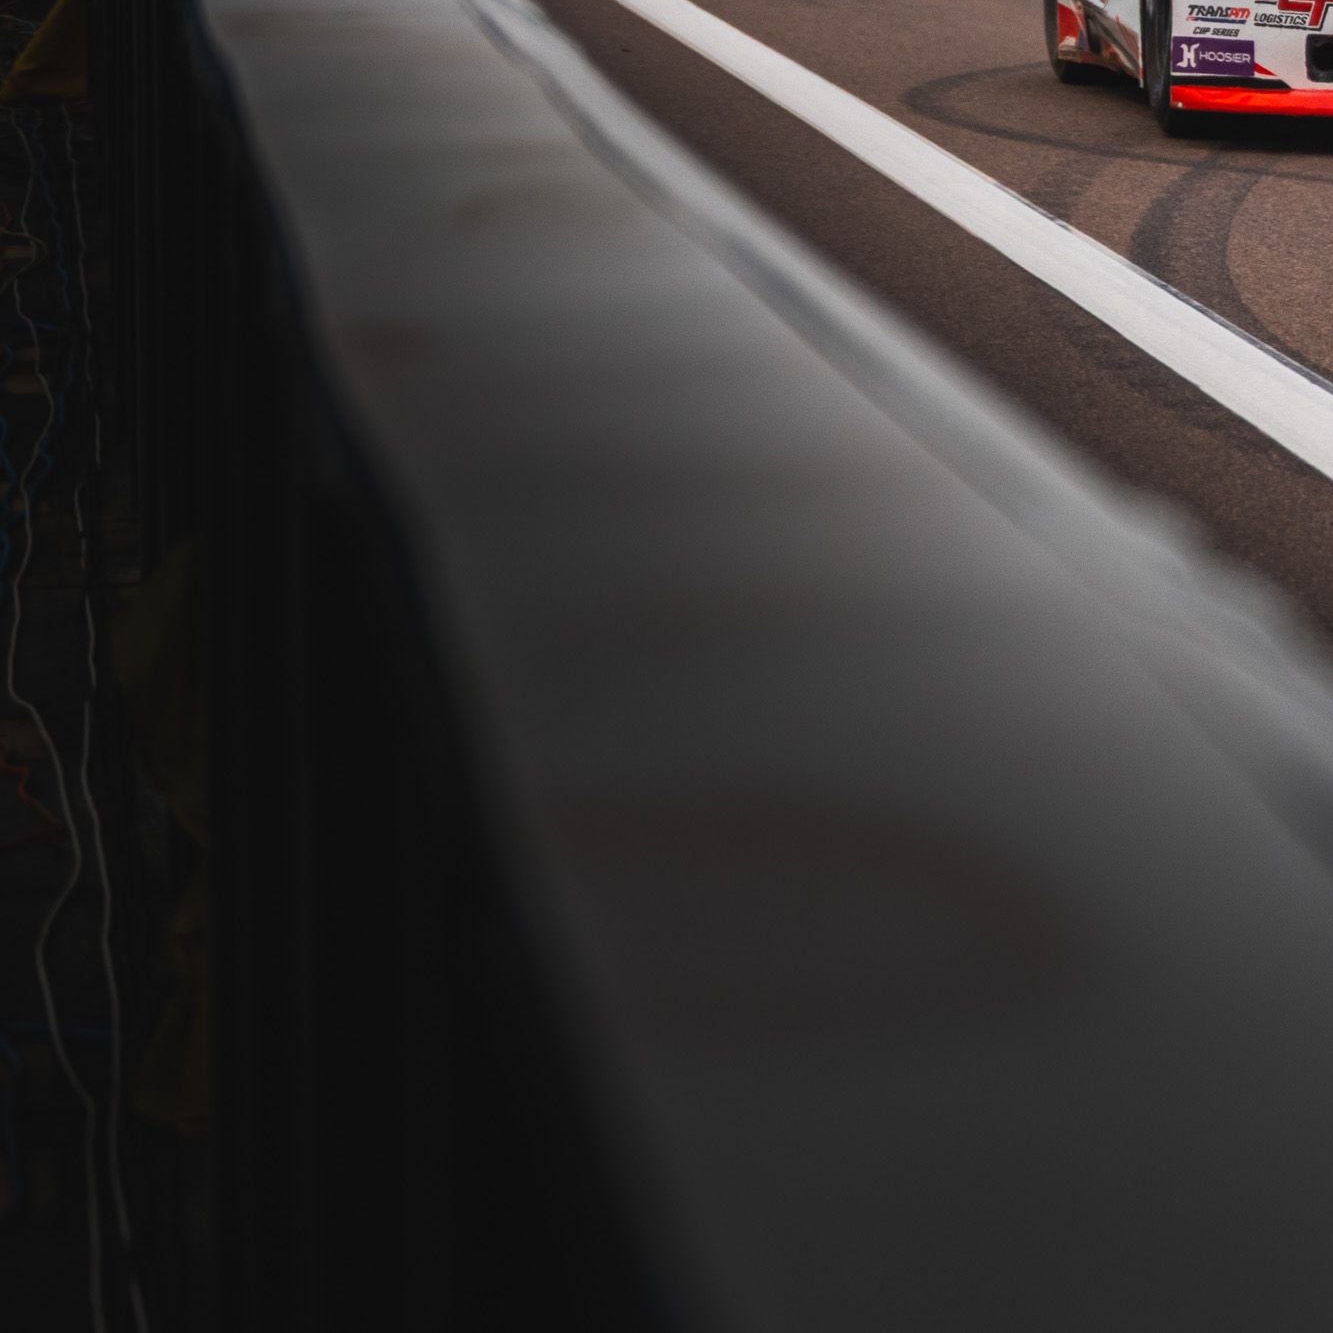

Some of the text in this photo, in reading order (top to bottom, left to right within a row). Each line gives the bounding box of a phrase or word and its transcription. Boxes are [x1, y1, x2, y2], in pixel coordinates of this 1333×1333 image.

[1253, 12, 1308, 26] LOGISTICS
[1192, 26, 1241, 38] CUP SERIES
[1200, 48, 1252, 63] HOOSIER
